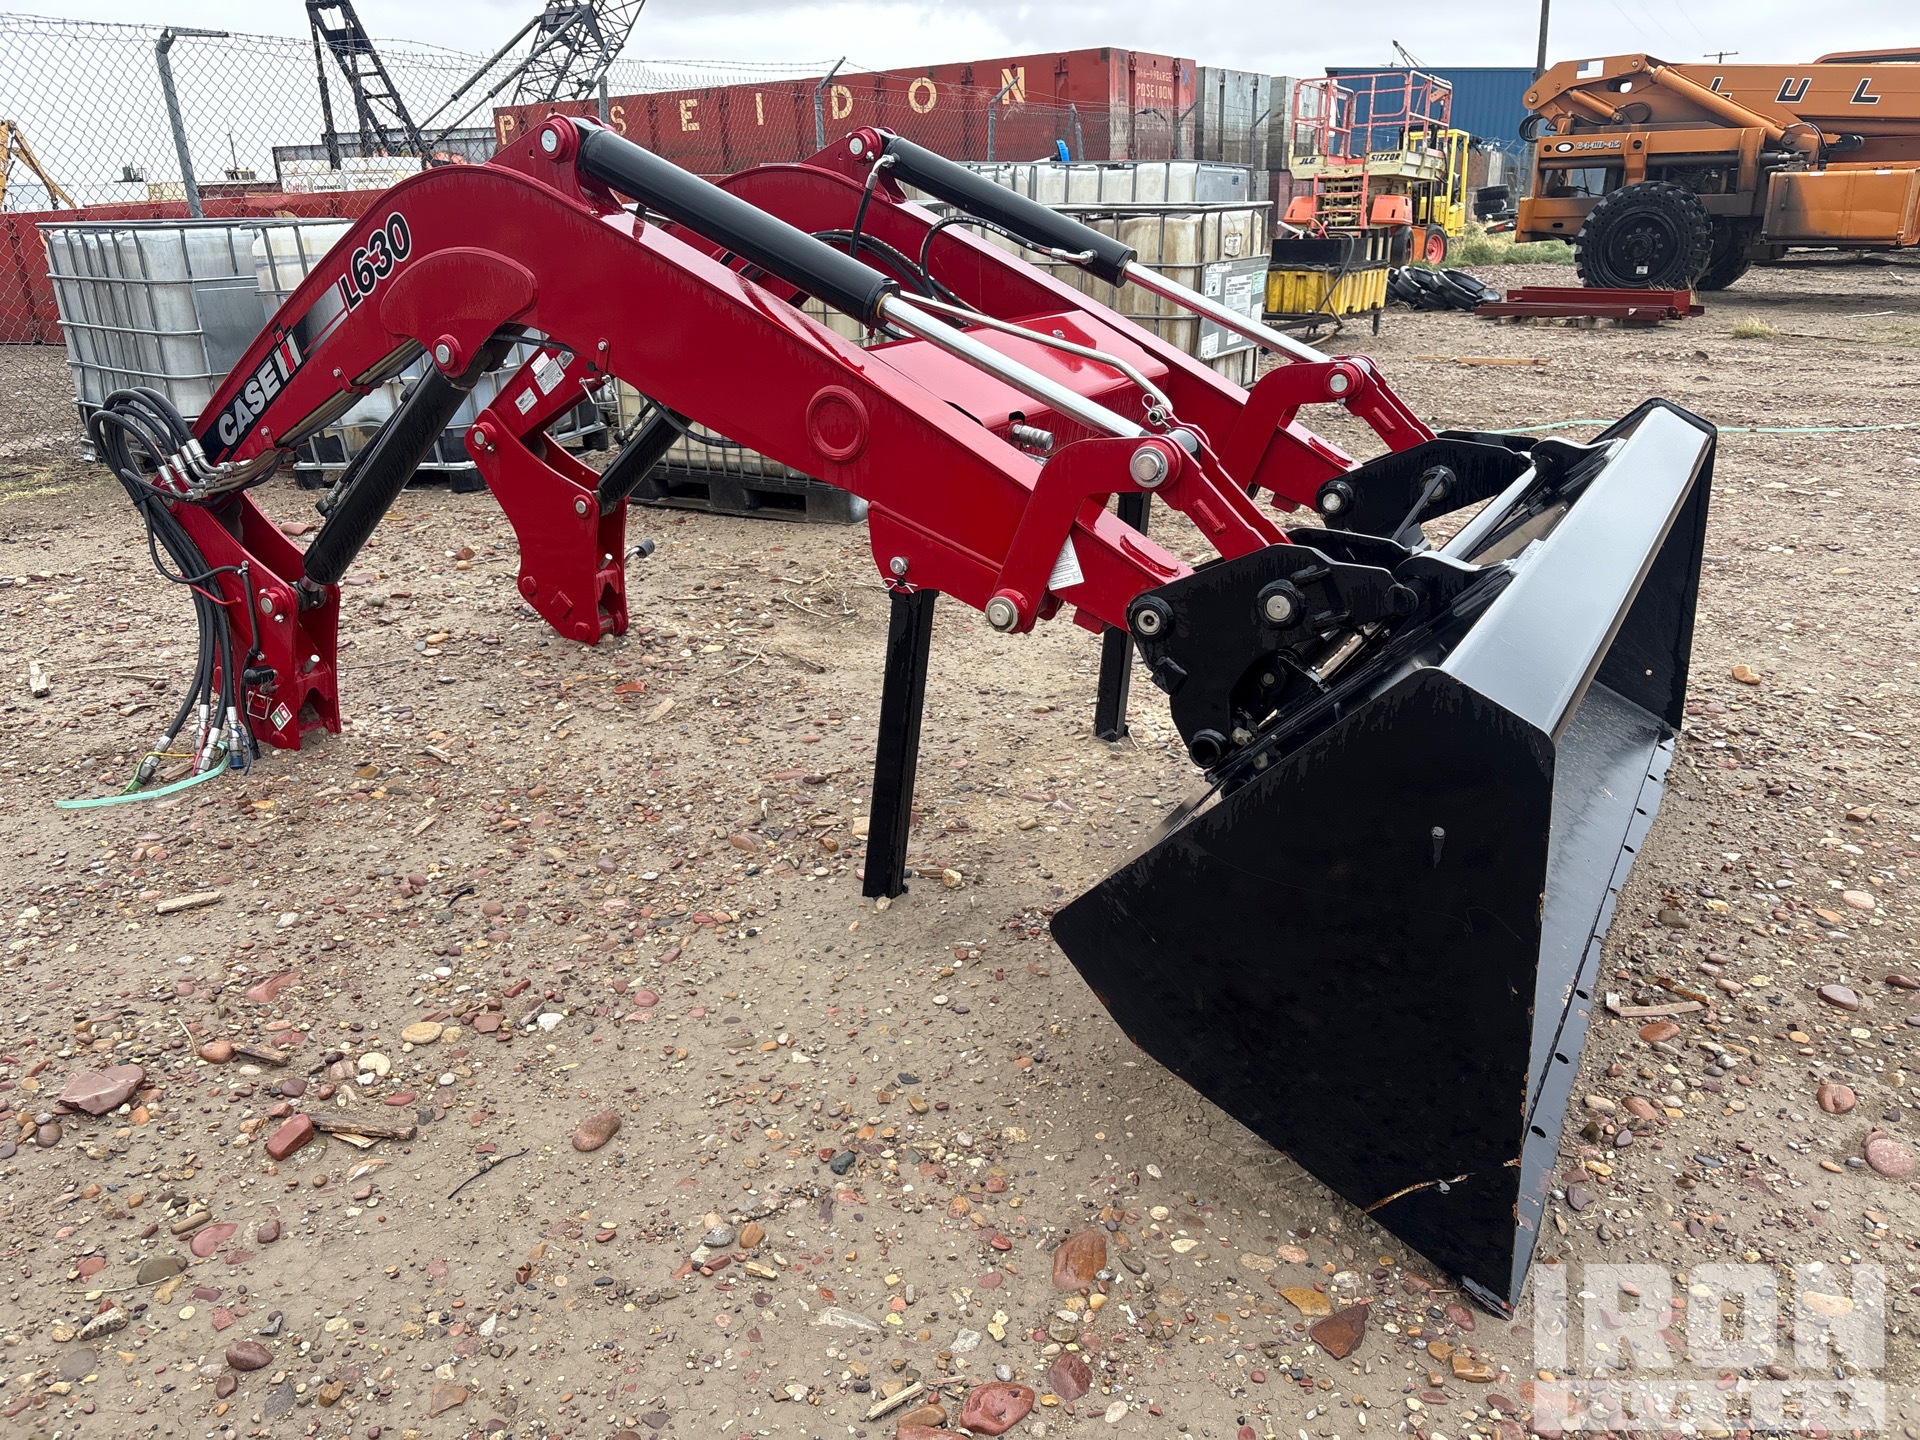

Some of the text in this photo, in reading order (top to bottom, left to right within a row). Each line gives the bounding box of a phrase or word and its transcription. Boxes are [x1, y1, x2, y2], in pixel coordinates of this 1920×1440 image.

[1136, 82, 1173, 100] POSEIDON
[498, 66, 1026, 145] PSEIDON
[1299, 157, 1317, 165] JLG
[1371, 153, 1401, 161] SIZZOR
[338, 212, 411, 313] L630
